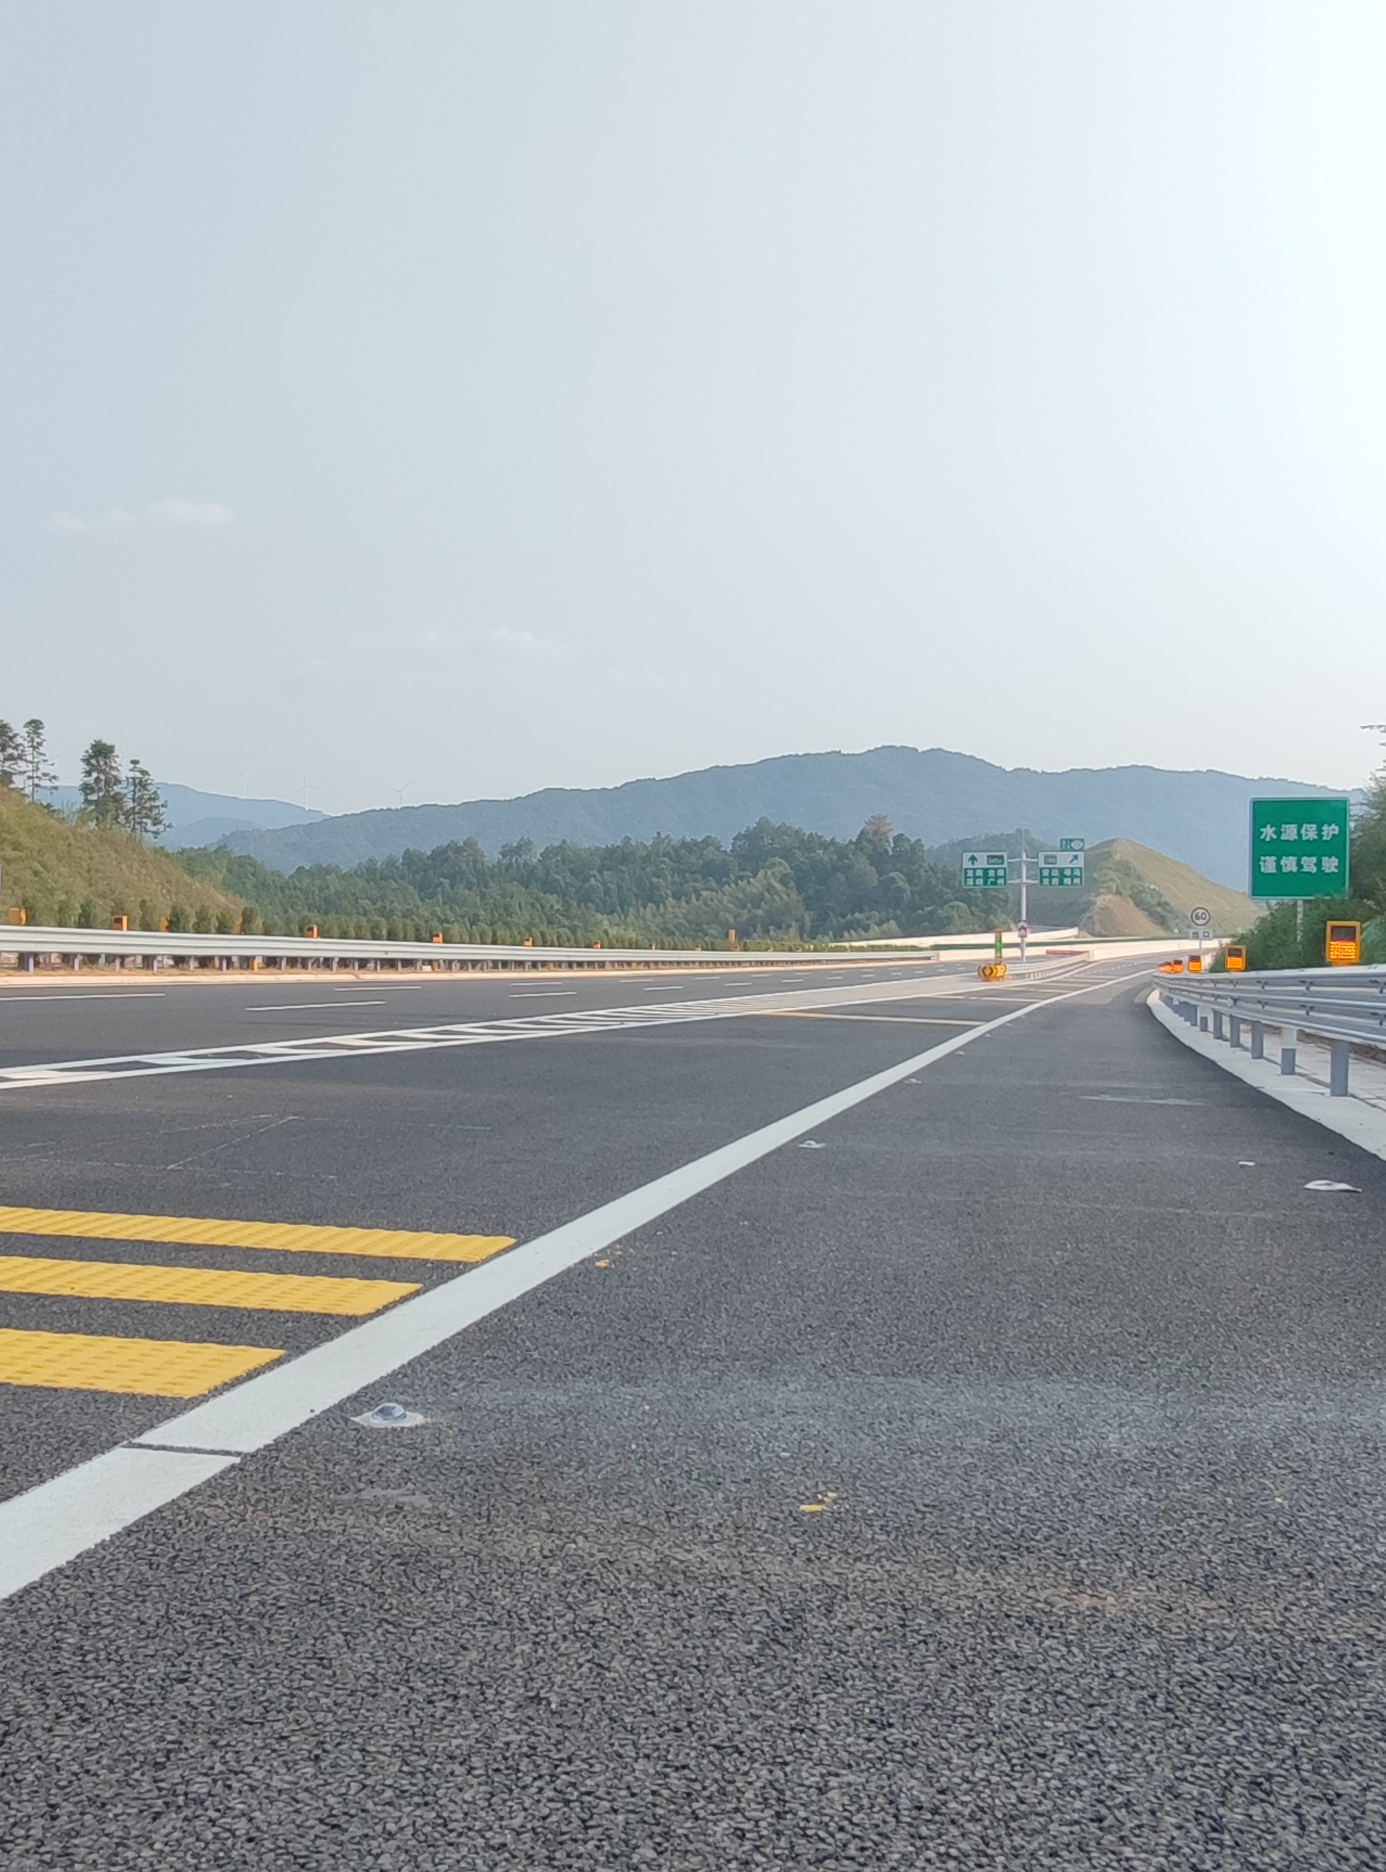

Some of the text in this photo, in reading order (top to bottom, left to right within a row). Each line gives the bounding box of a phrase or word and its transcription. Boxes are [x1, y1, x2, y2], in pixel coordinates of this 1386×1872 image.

[1259, 823, 1340, 842] 水源保护
[1259, 855, 1340, 874] 谨慎驾驶
[1194, 911, 1207, 921] 60
